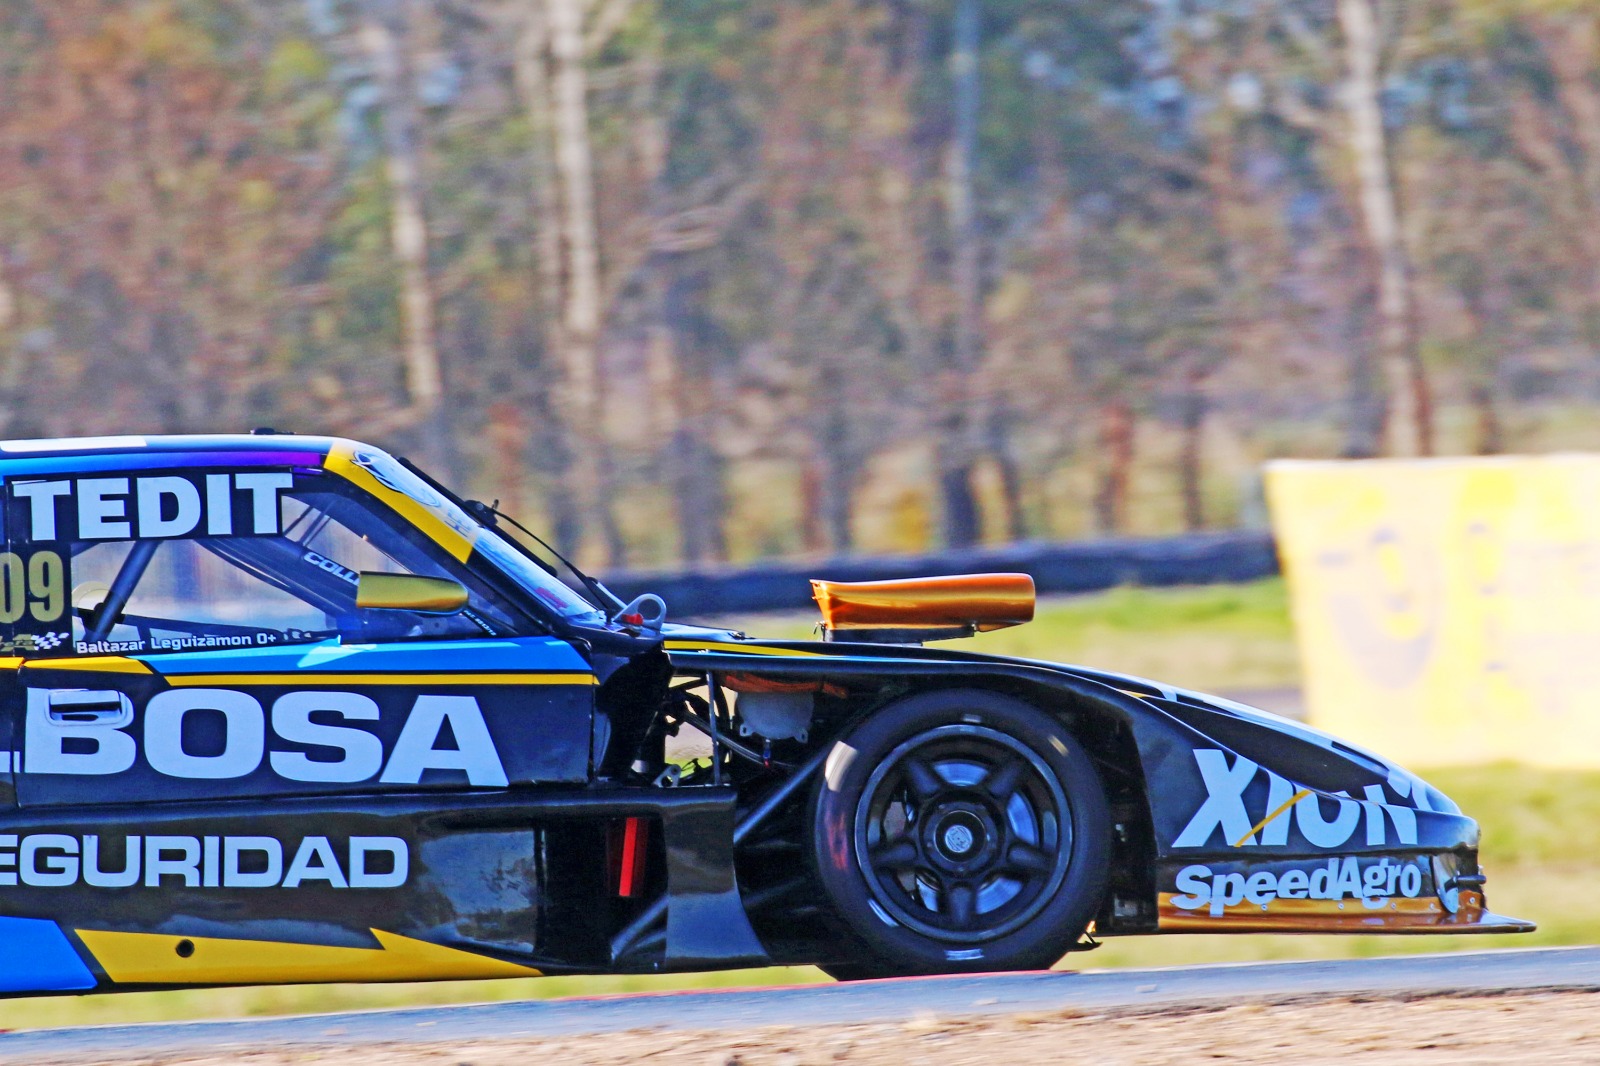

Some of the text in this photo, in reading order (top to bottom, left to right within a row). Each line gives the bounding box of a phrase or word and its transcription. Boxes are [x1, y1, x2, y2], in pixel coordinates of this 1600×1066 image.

[11, 473, 293, 541] TEDIT
[303, 551, 361, 587] COLL
[76, 639, 145, 654] Baltazar
[151, 632, 252, 650] Leguizamon
[0, 686, 510, 787] BOSA
[1171, 748, 1417, 848] XION
[1170, 856, 1422, 917] SpeedAgro
